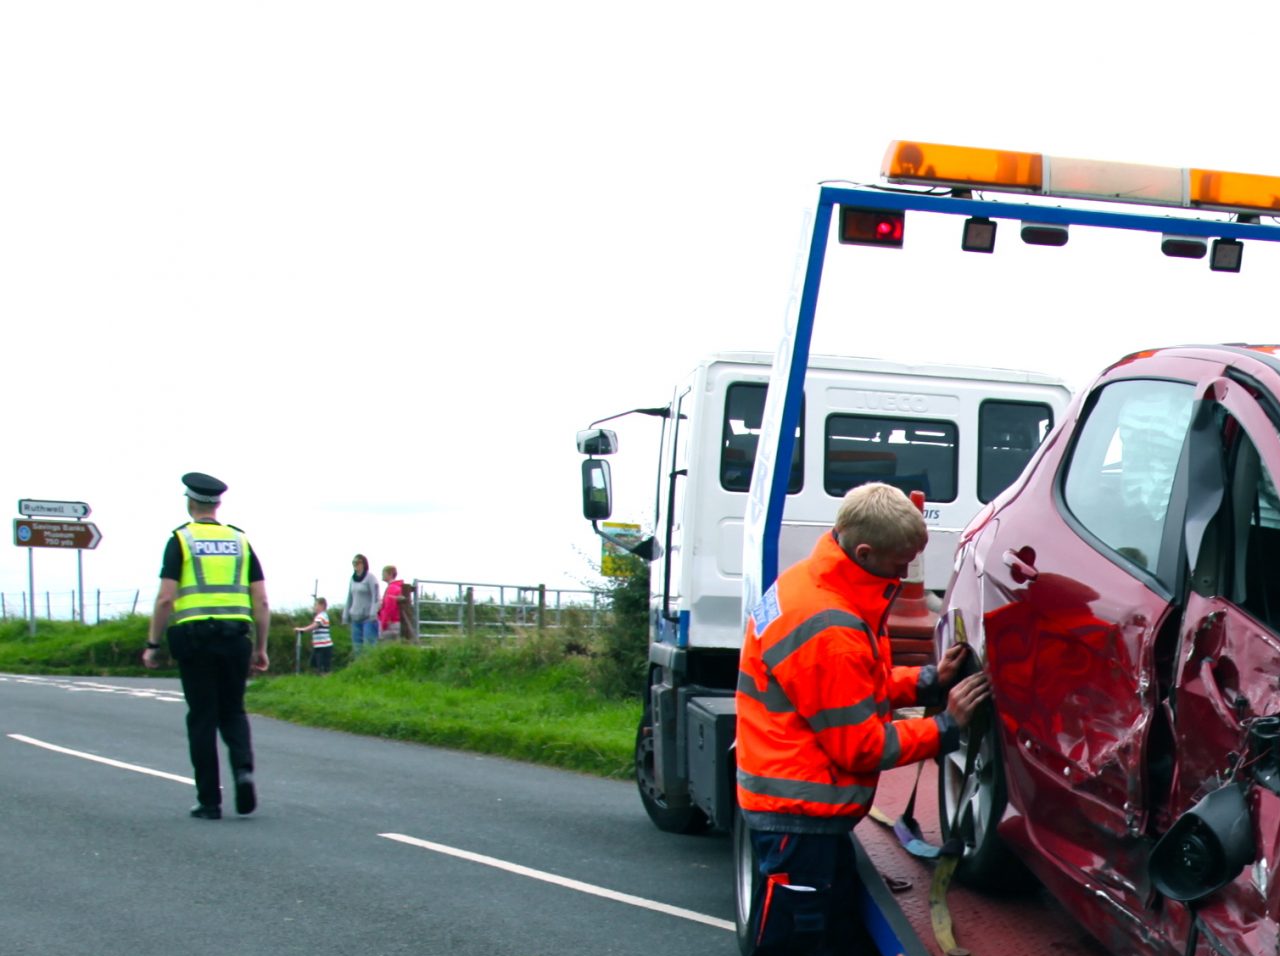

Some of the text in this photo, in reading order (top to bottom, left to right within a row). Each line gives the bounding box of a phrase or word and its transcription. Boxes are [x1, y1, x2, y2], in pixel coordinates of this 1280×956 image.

[855, 391, 929, 413] IVECO
[24, 504, 64, 513] Ruthwell
[195, 542, 238, 553] POLICE
